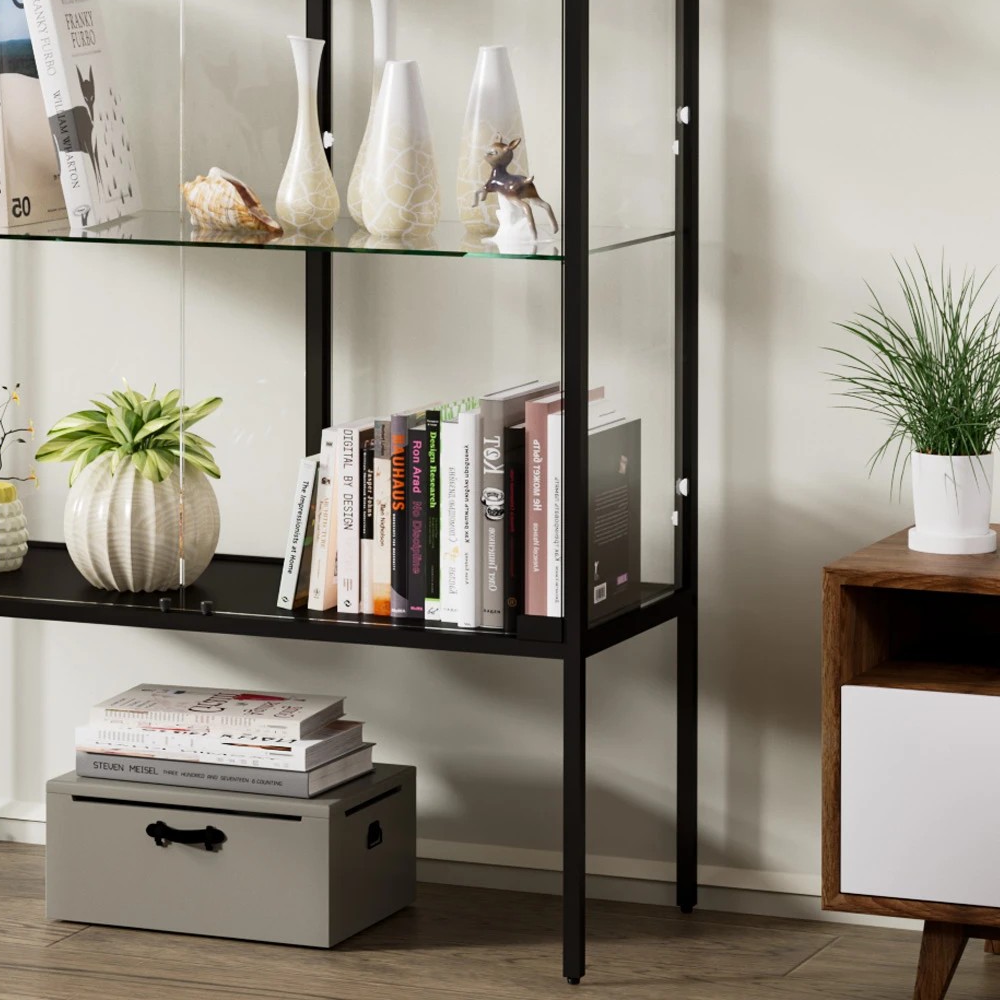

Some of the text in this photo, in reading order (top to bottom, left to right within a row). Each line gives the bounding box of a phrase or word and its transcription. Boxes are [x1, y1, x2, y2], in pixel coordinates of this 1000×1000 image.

[64, 10, 94, 30] FRANKY
[70, 29, 97, 49] FURBO
[39, 36, 58, 77] FURBO
[51, 89, 70, 135] WILLIAM
[61, 135, 81, 190] WHARTON
[428, 431, 437, 463] Design
[301, 480, 310, 494] The
[343, 429, 353, 531] DIGITAL BY DESIGN
[391, 433, 405, 511] BAUHAUS
[292, 495, 307, 544] Impressionists
[411, 440, 422, 575] Ron Arad No Discipline
[287, 555, 297, 575] Home
[92, 760, 125, 772] STEVEN
[129, 764, 159, 776] MEISEL
